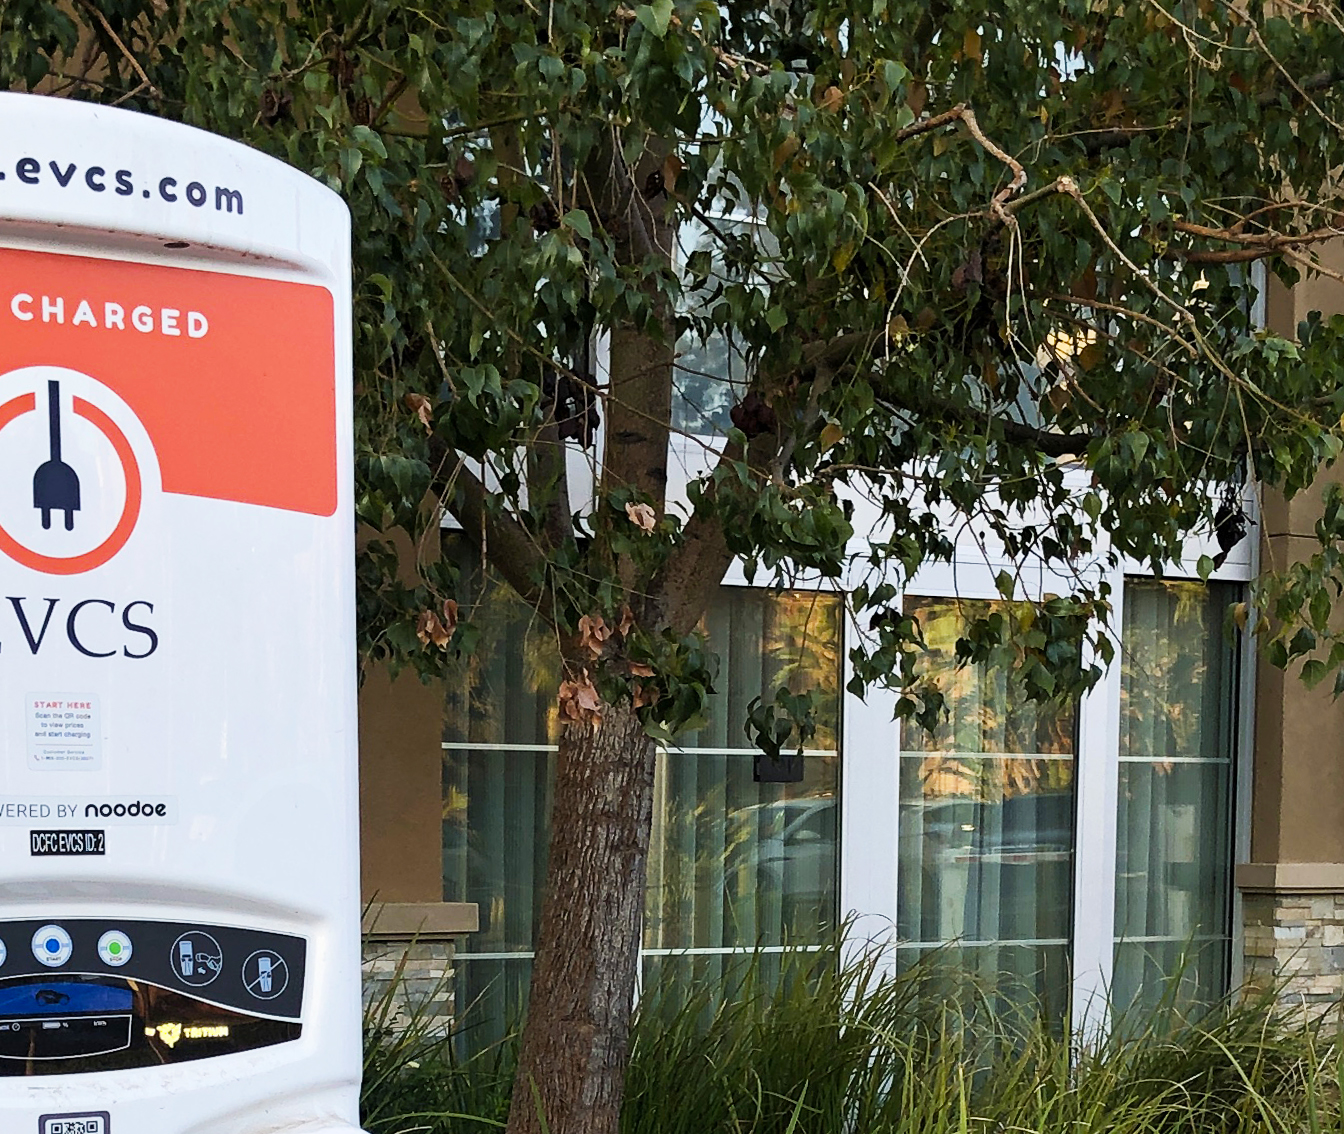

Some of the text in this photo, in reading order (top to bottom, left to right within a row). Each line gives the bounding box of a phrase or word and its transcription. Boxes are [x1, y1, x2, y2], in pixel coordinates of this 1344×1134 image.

[11, 293, 210, 339] CHARGED
[34, 701, 63, 709] START
[57, 804, 78, 818] BY
[84, 800, 167, 818] noodoe
[32, 833, 57, 852] DCFC
[59, 833, 83, 852] EVCS
[98, 833, 104, 852] 2
